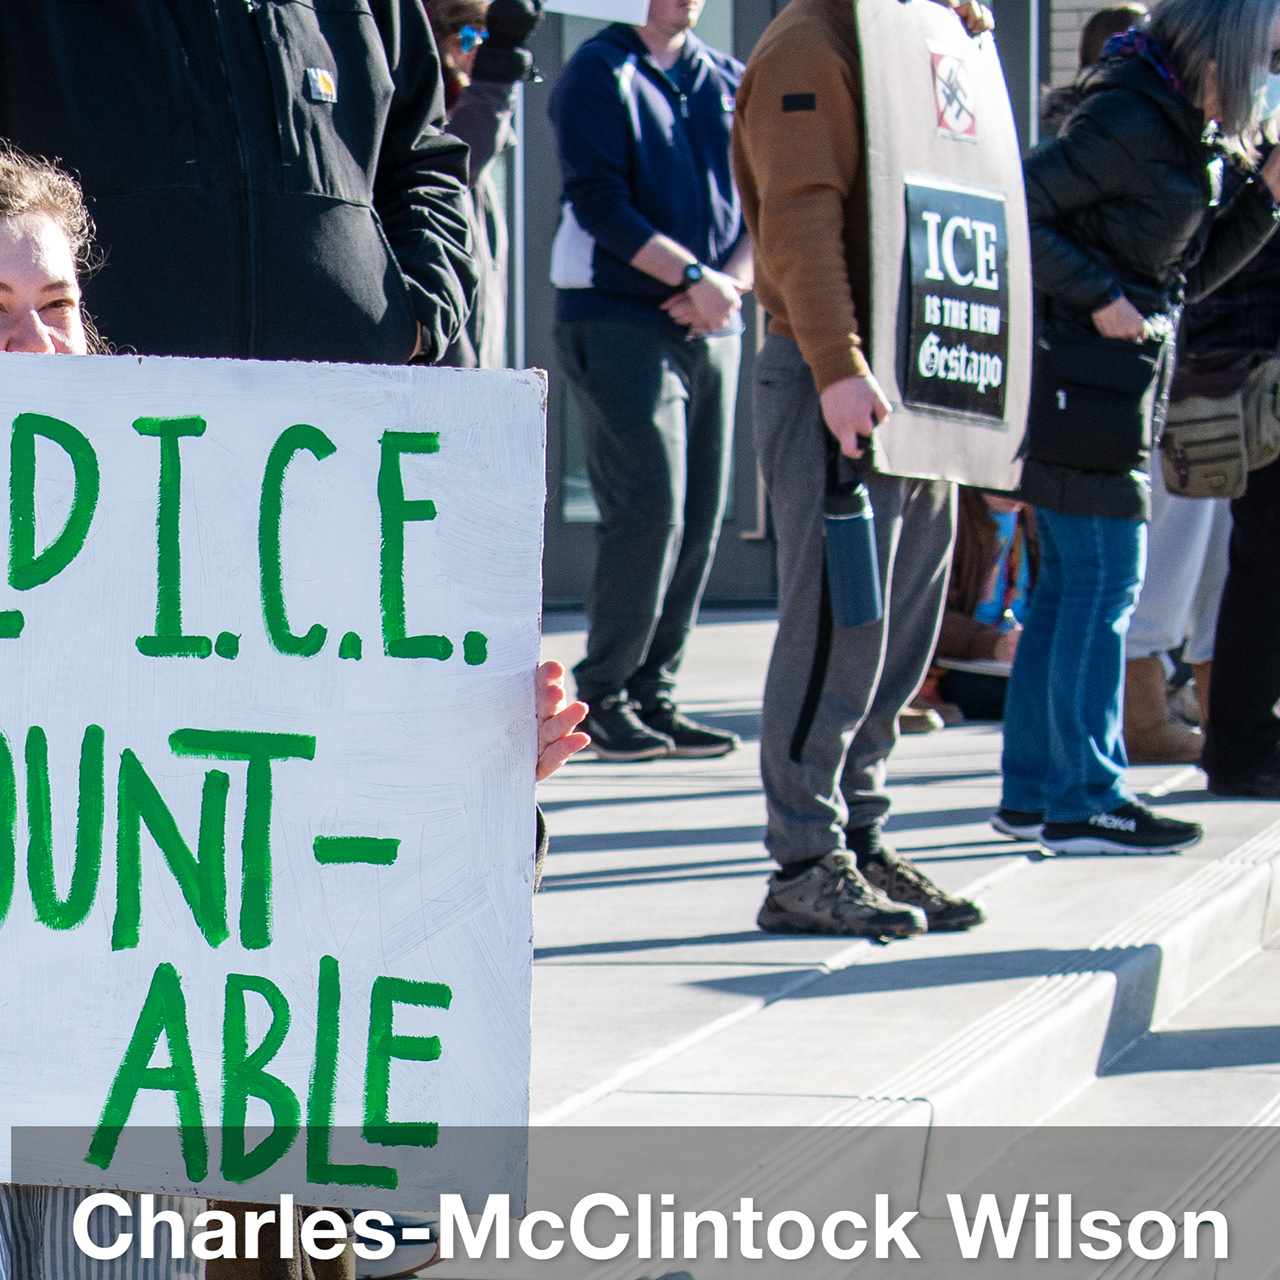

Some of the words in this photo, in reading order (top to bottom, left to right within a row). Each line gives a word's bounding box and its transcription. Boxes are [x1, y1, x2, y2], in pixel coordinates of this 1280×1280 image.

[921, 210, 1000, 291] ICE
[924, 294, 941, 326] IS
[942, 297, 968, 330] THE
[969, 302, 1001, 335] NEW
[918, 331, 1003, 394] Gestapo
[131, 414, 489, 665] I.C.E.
[84, 954, 453, 1189] ABLE
